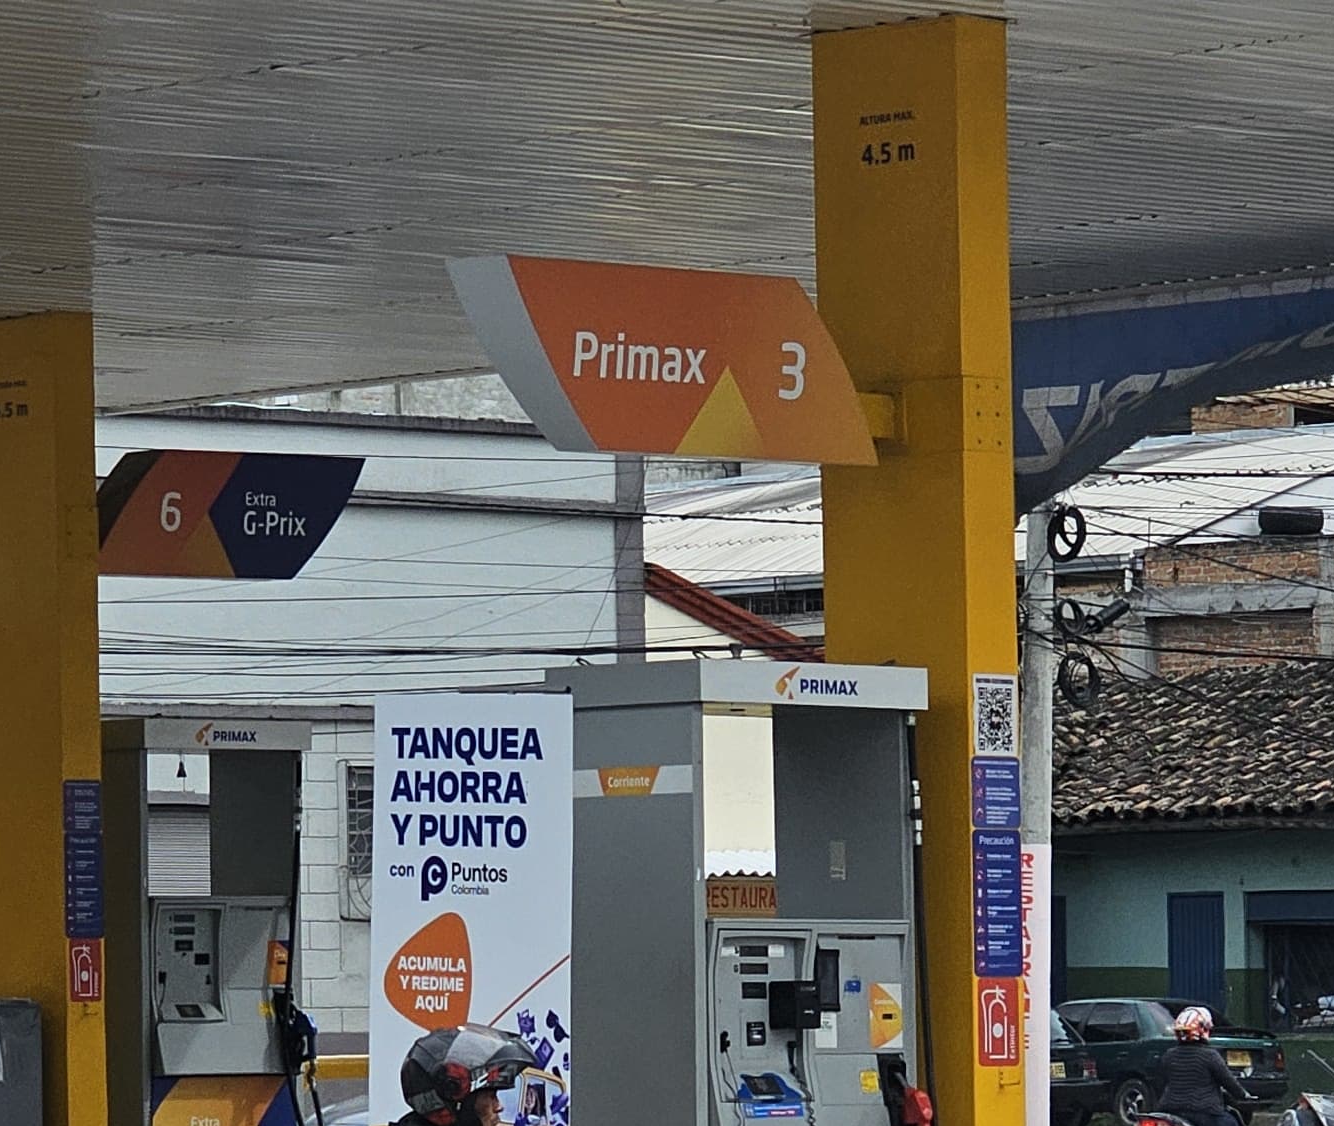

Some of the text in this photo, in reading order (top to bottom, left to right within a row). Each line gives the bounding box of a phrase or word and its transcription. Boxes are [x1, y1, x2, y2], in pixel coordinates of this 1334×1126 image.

[861, 142, 915, 165] 4.5 m
[573, 331, 707, 384] Primax
[778, 341, 807, 401] 3
[245, 491, 276, 506] Extra
[160, 491, 182, 532] 6
[243, 510, 306, 537] G-Prix
[799, 678, 858, 696] PRIMAX
[213, 730, 257, 742] PRIMAX
[391, 727, 543, 766] TANQUEA
[390, 770, 527, 804] AHORRA
[607, 776, 650, 788] Corriente
[390, 814, 527, 849] Y PUNTO
[389, 864, 414, 877] con
[451, 862, 507, 883] Puntos
[451, 885, 489, 895] Colombia
[397, 955, 466, 972] ACUMULA
[399, 975, 464, 992] Y REDIME
[415, 993, 450, 1013] AQUÍ
